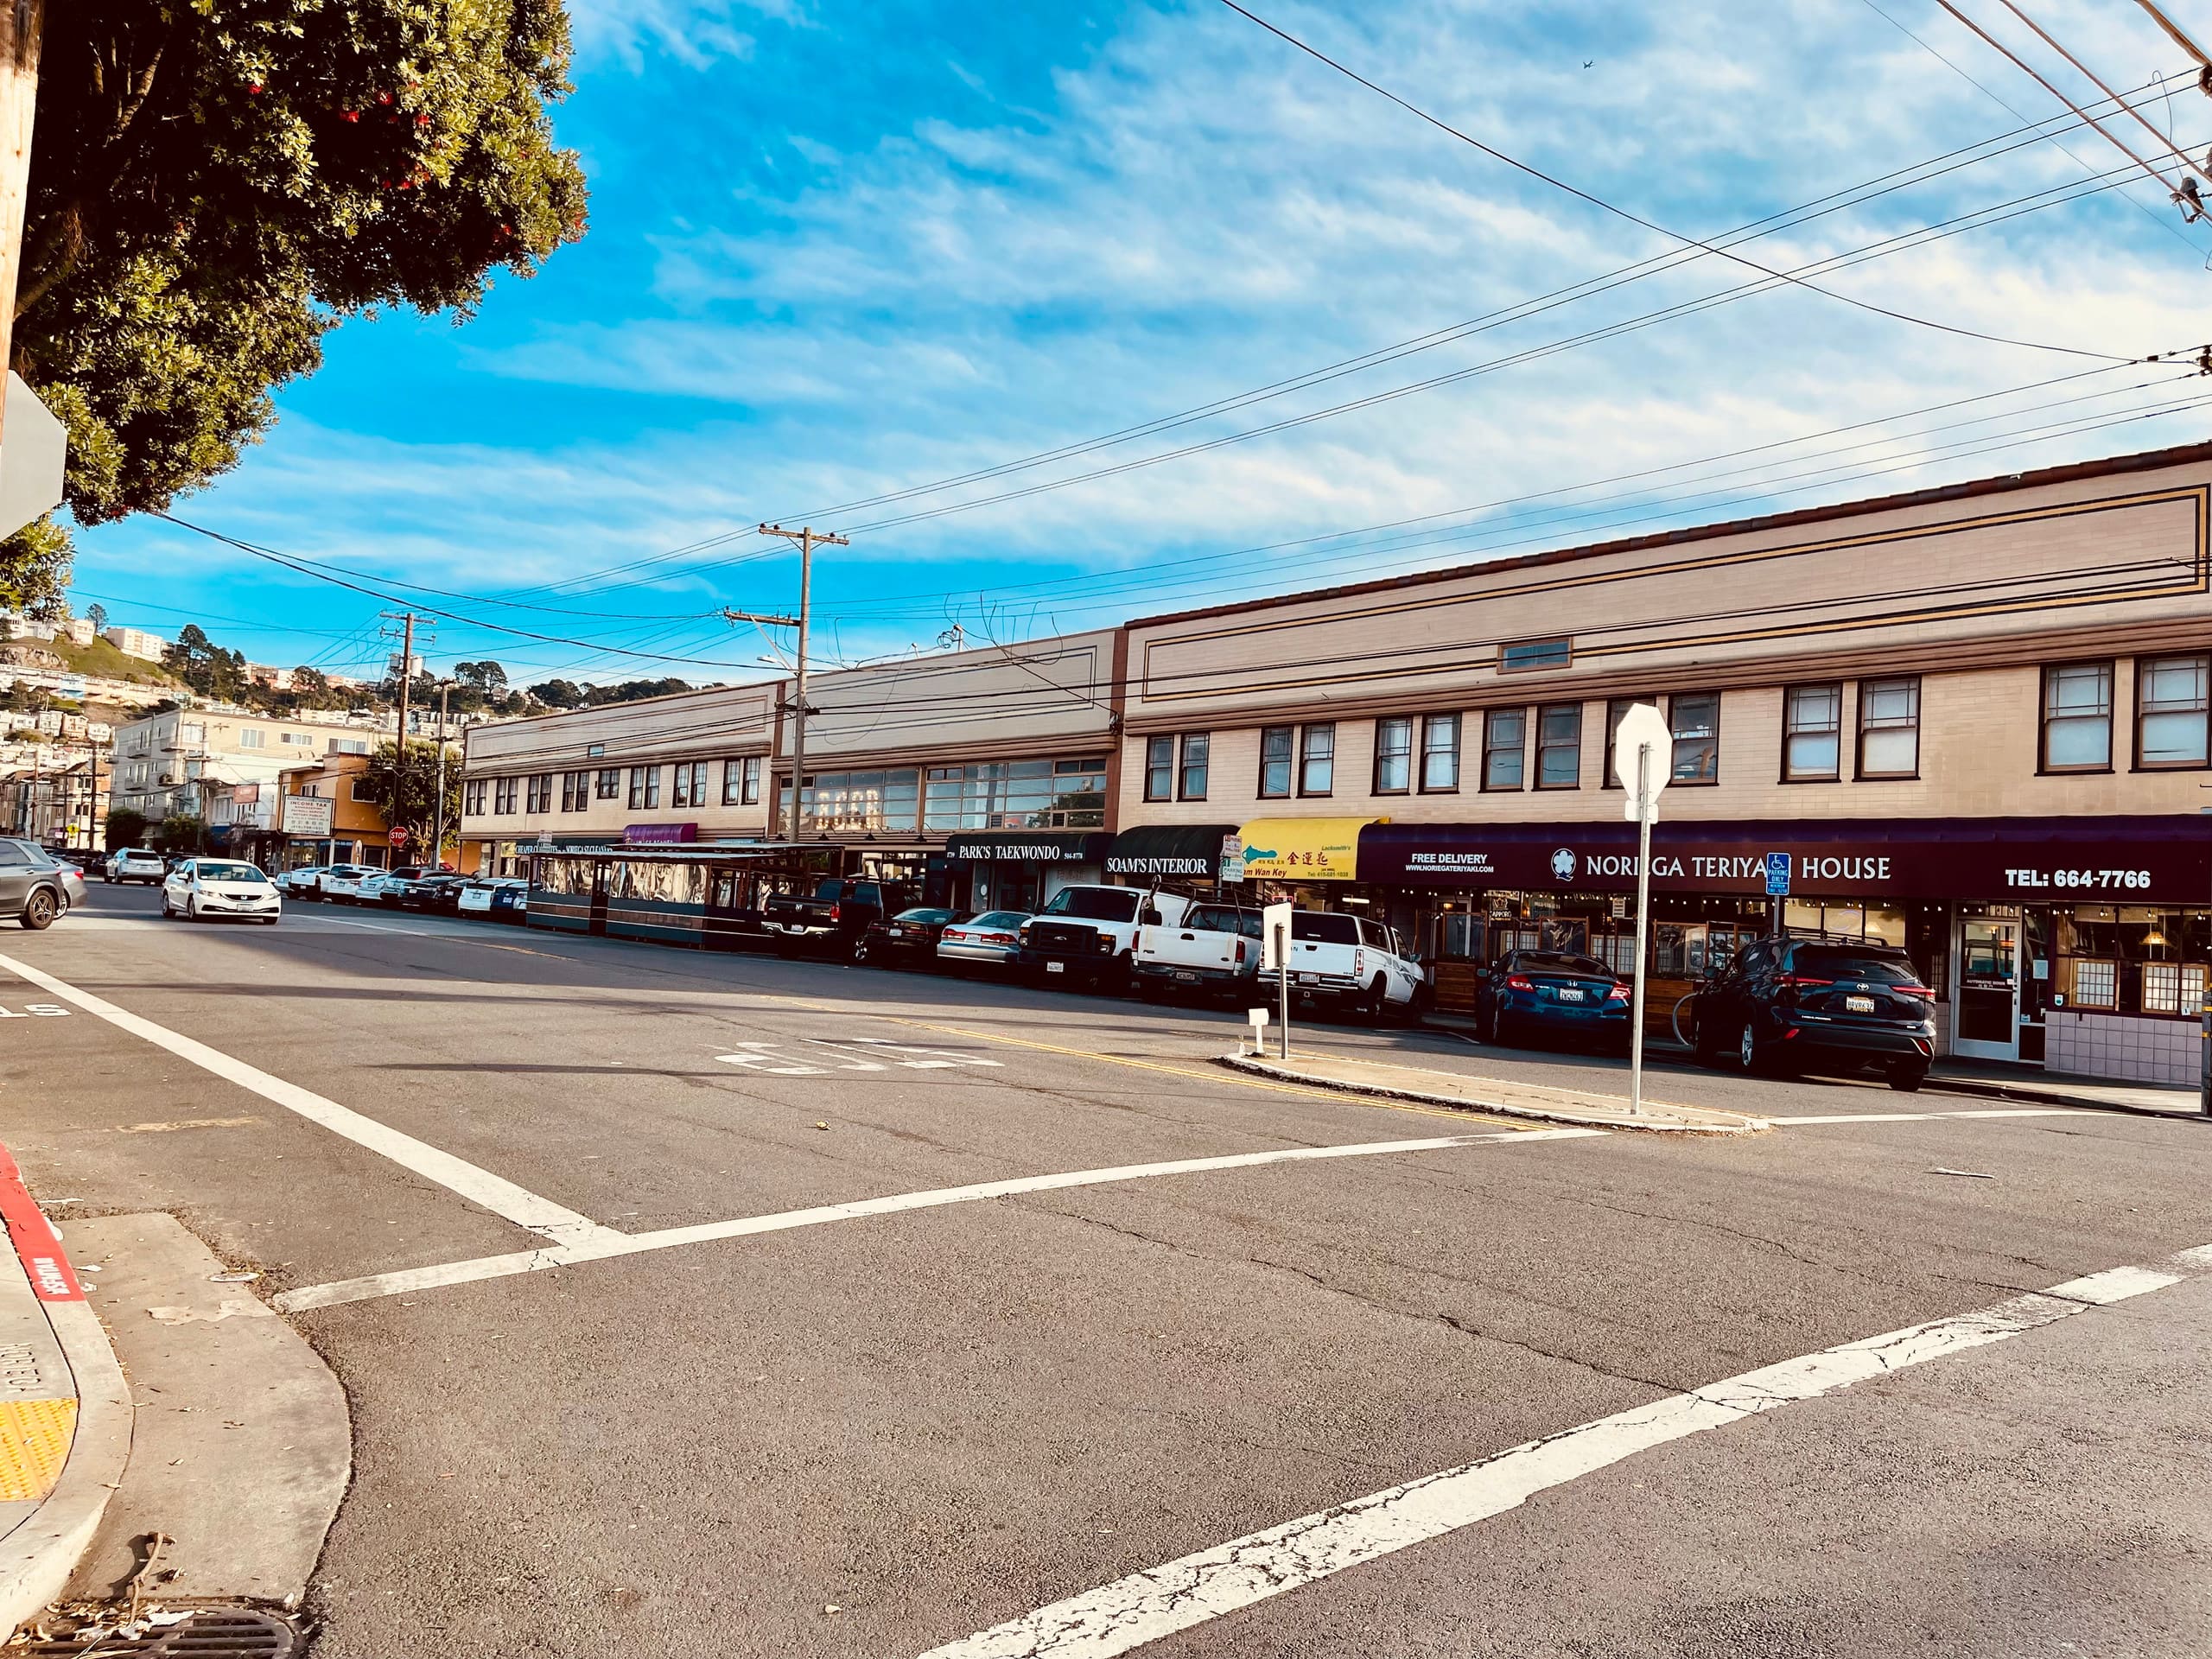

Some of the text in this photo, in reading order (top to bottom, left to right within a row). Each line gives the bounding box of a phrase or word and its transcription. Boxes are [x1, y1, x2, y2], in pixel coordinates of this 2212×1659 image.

[959, 845, 1060, 860] PARK'S TAEKWONDO
[1411, 854, 1488, 864] FREE DELIVERY
[1107, 857, 1208, 874] SOAM'S INTERIOR
[1272, 868, 1287, 878] Key
[1691, 856, 1792, 879] TERIYA
[1802, 857, 1891, 880] HOUSE
[2005, 868, 2151, 888] TEL: 664-7766
